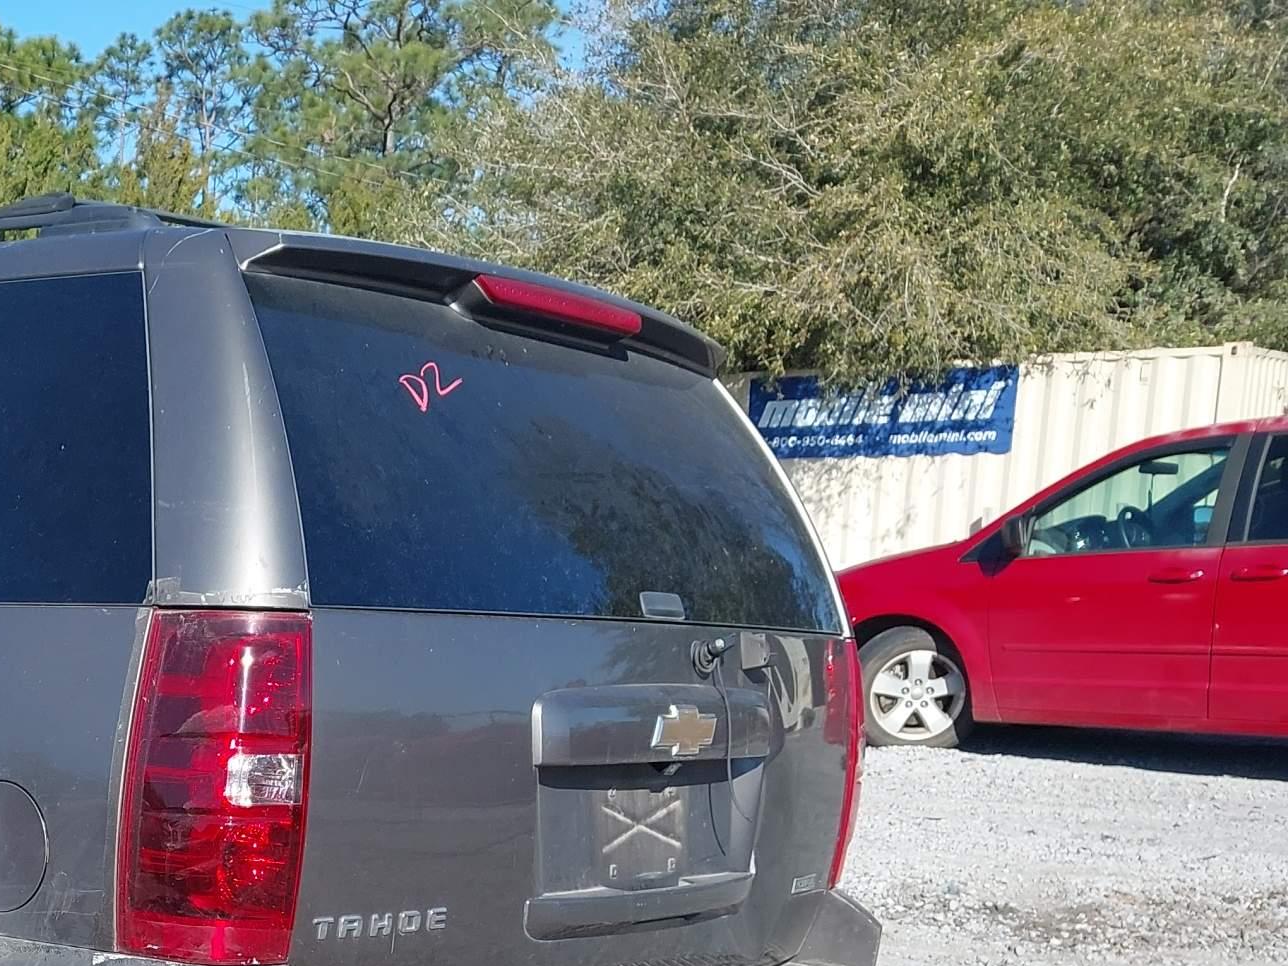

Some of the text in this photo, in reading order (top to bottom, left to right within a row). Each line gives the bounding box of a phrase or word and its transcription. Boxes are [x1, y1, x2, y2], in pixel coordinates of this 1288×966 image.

[398, 361, 463, 412] D2
[898, 380, 1006, 423] mini
[312, 907, 447, 940] TAHOE
